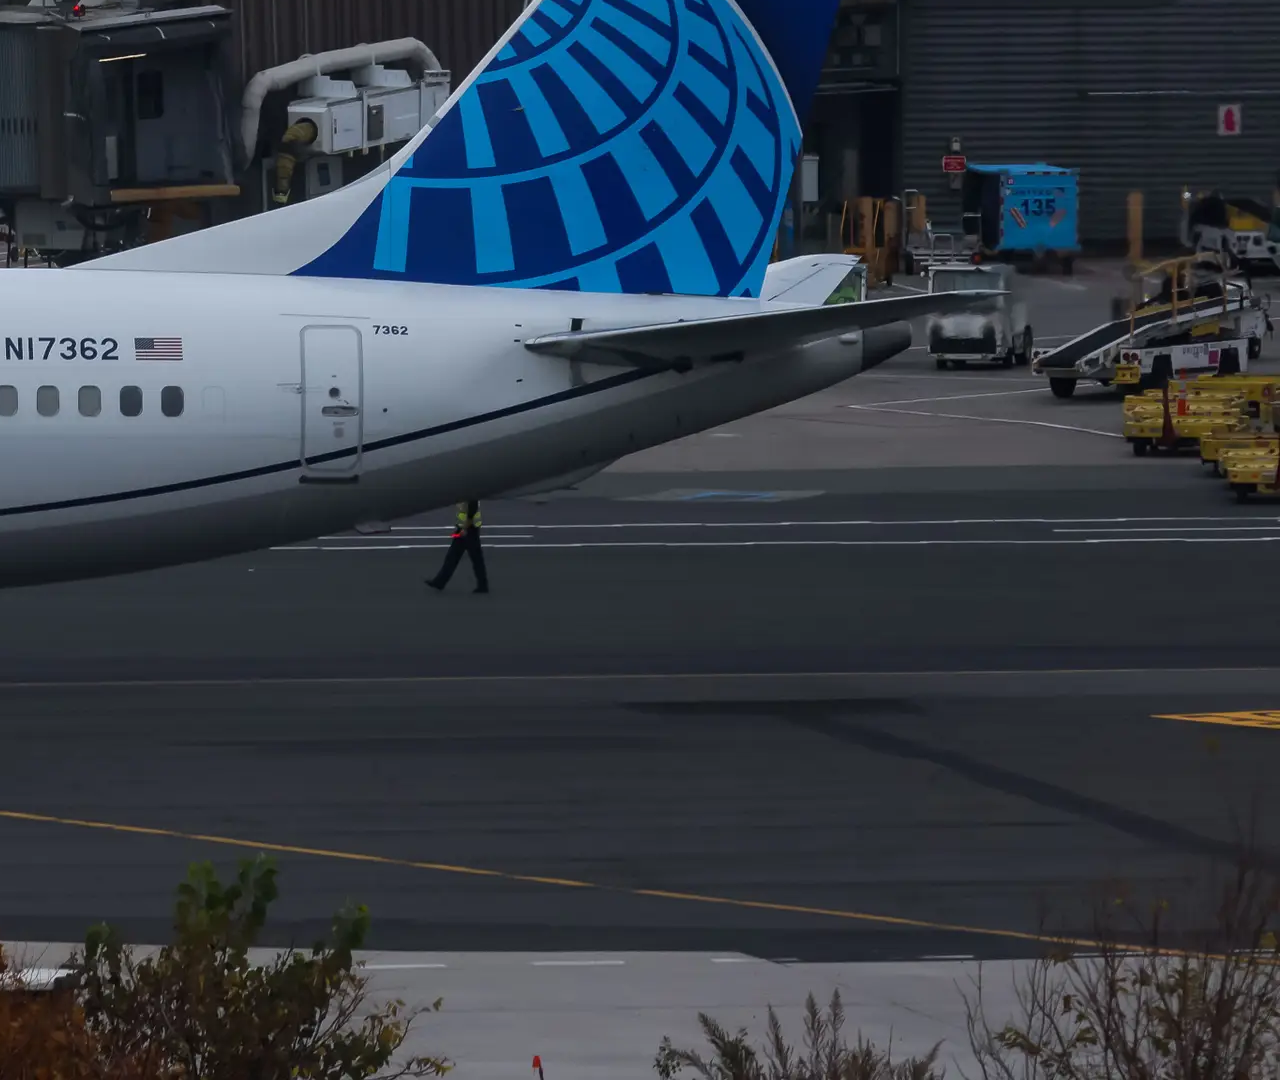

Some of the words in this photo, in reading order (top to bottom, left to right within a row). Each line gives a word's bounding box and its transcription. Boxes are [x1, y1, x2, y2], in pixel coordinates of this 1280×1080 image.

[1020, 198, 1056, 218] 135
[372, 325, 409, 336] 7362
[5, 337, 119, 361] N17362
